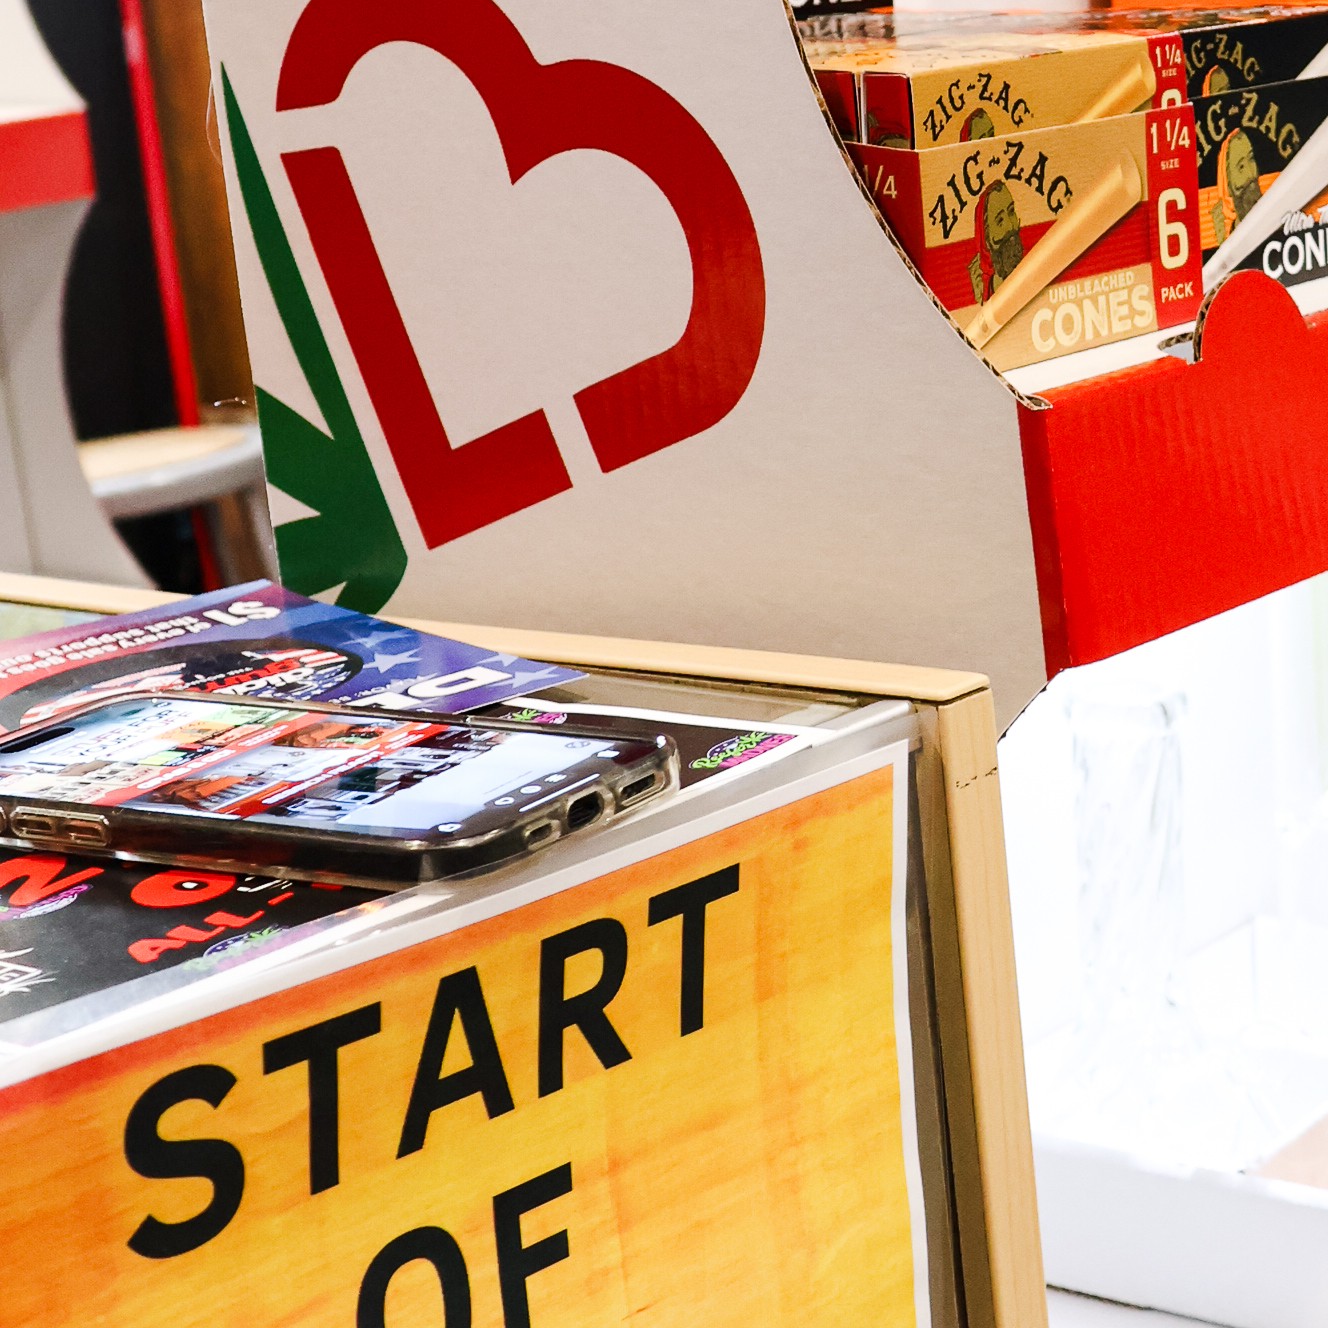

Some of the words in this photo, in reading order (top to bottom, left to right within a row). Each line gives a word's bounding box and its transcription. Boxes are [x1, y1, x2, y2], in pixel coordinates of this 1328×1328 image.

[1186, 33, 1262, 85] IG-ZAG
[922, 72, 1034, 142] ZIG-ZAG
[1196, 91, 1300, 168] IG-ZAG
[929, 140, 1073, 239] ZIG-ZAG
[1160, 157, 1180, 171] SIZE
[1157, 187, 1189, 270] 6
[1281, 209, 1315, 235] Ultra
[1049, 270, 1135, 304] UNBLEACHED
[1161, 282, 1194, 304] PACK
[1031, 285, 1155, 354] CONES
[203, 600, 281, 627] $1
[125, 861, 741, 1261] START
